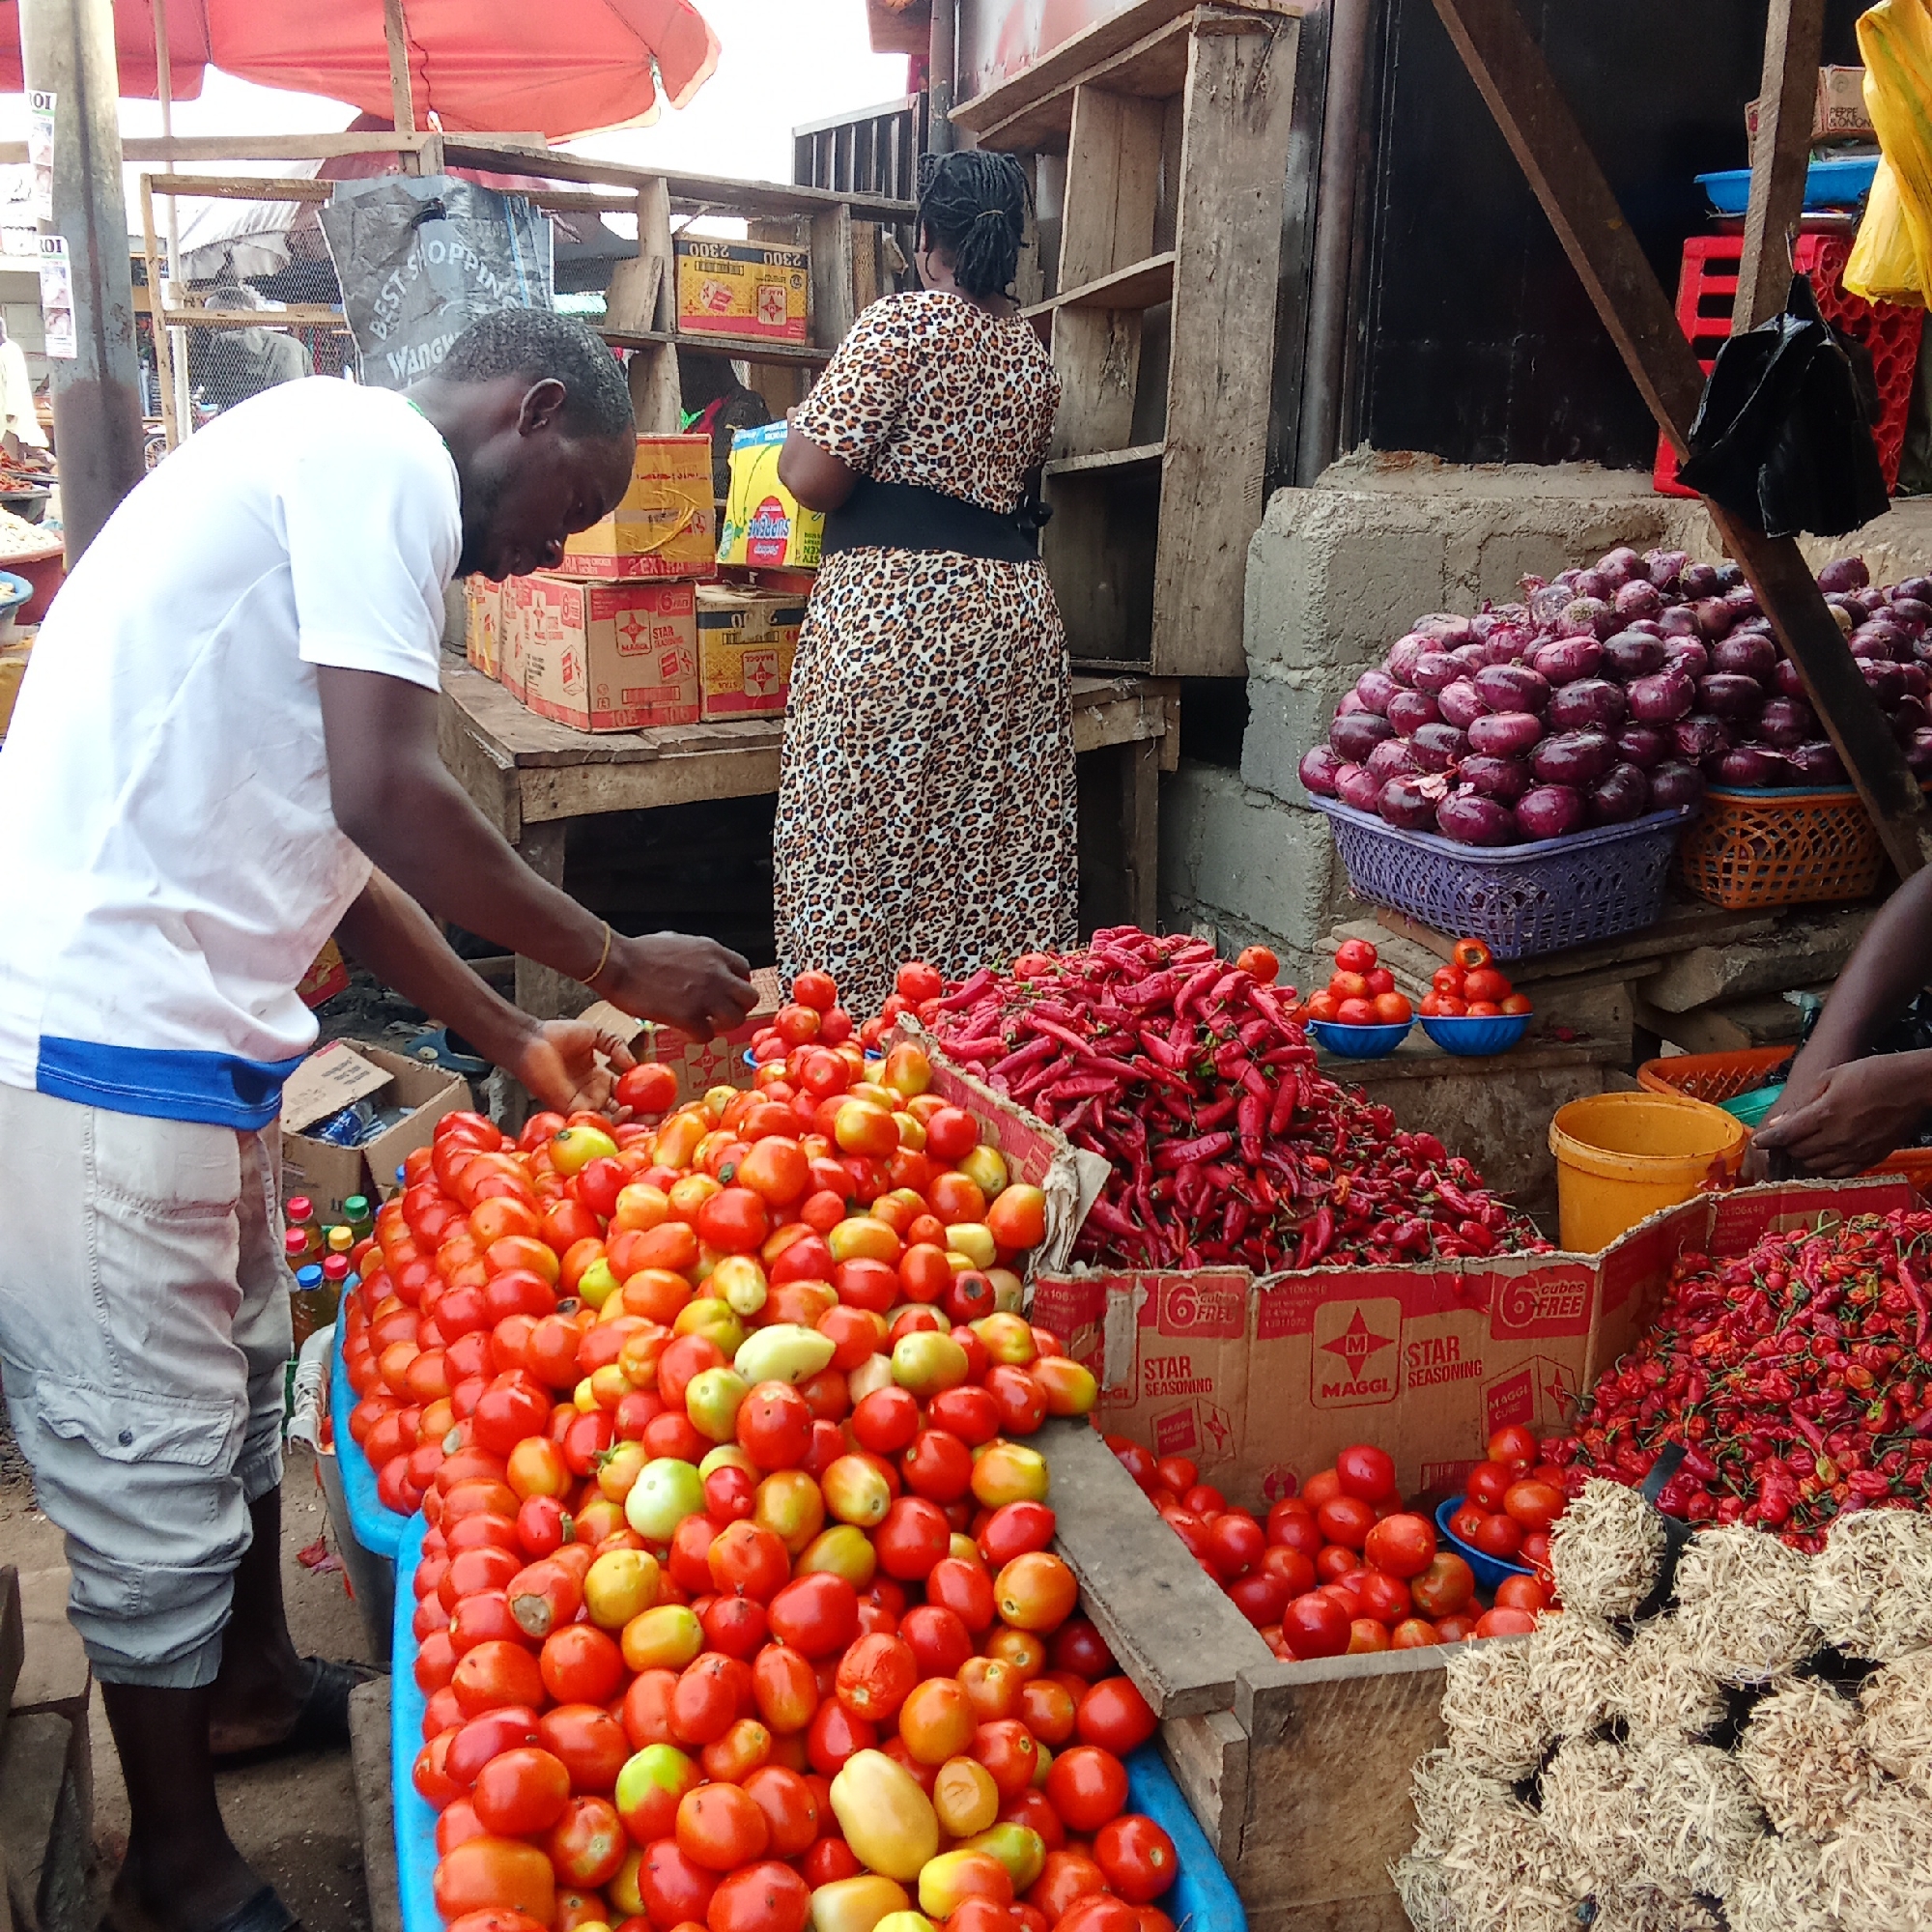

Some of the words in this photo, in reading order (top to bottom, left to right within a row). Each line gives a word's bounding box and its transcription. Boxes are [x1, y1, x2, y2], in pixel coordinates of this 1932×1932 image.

[690, 242, 730, 258] 2300
[764, 252, 802, 267] 2300
[369, 270, 408, 341] BEST
[748, 515, 790, 539] SUPREME
[652, 626, 674, 639] STAR
[1541, 1282, 1585, 1295] cubes
[1165, 1282, 1200, 1330] 6
[1499, 1274, 1541, 1328] 6
[1536, 1295, 1583, 1317] FREE
[1197, 1306, 1236, 1322] FREE
[1407, 1335, 1461, 1368] STAR
[1144, 1356, 1192, 1380] STAR
[1408, 1360, 1483, 1388] SEASONING
[1145, 1378, 1213, 1398] SEASONING
[1321, 1378, 1389, 1398] MAGGI
[1489, 1384, 1529, 1410] MAGGI
[1494, 1402, 1521, 1421] CUBE
